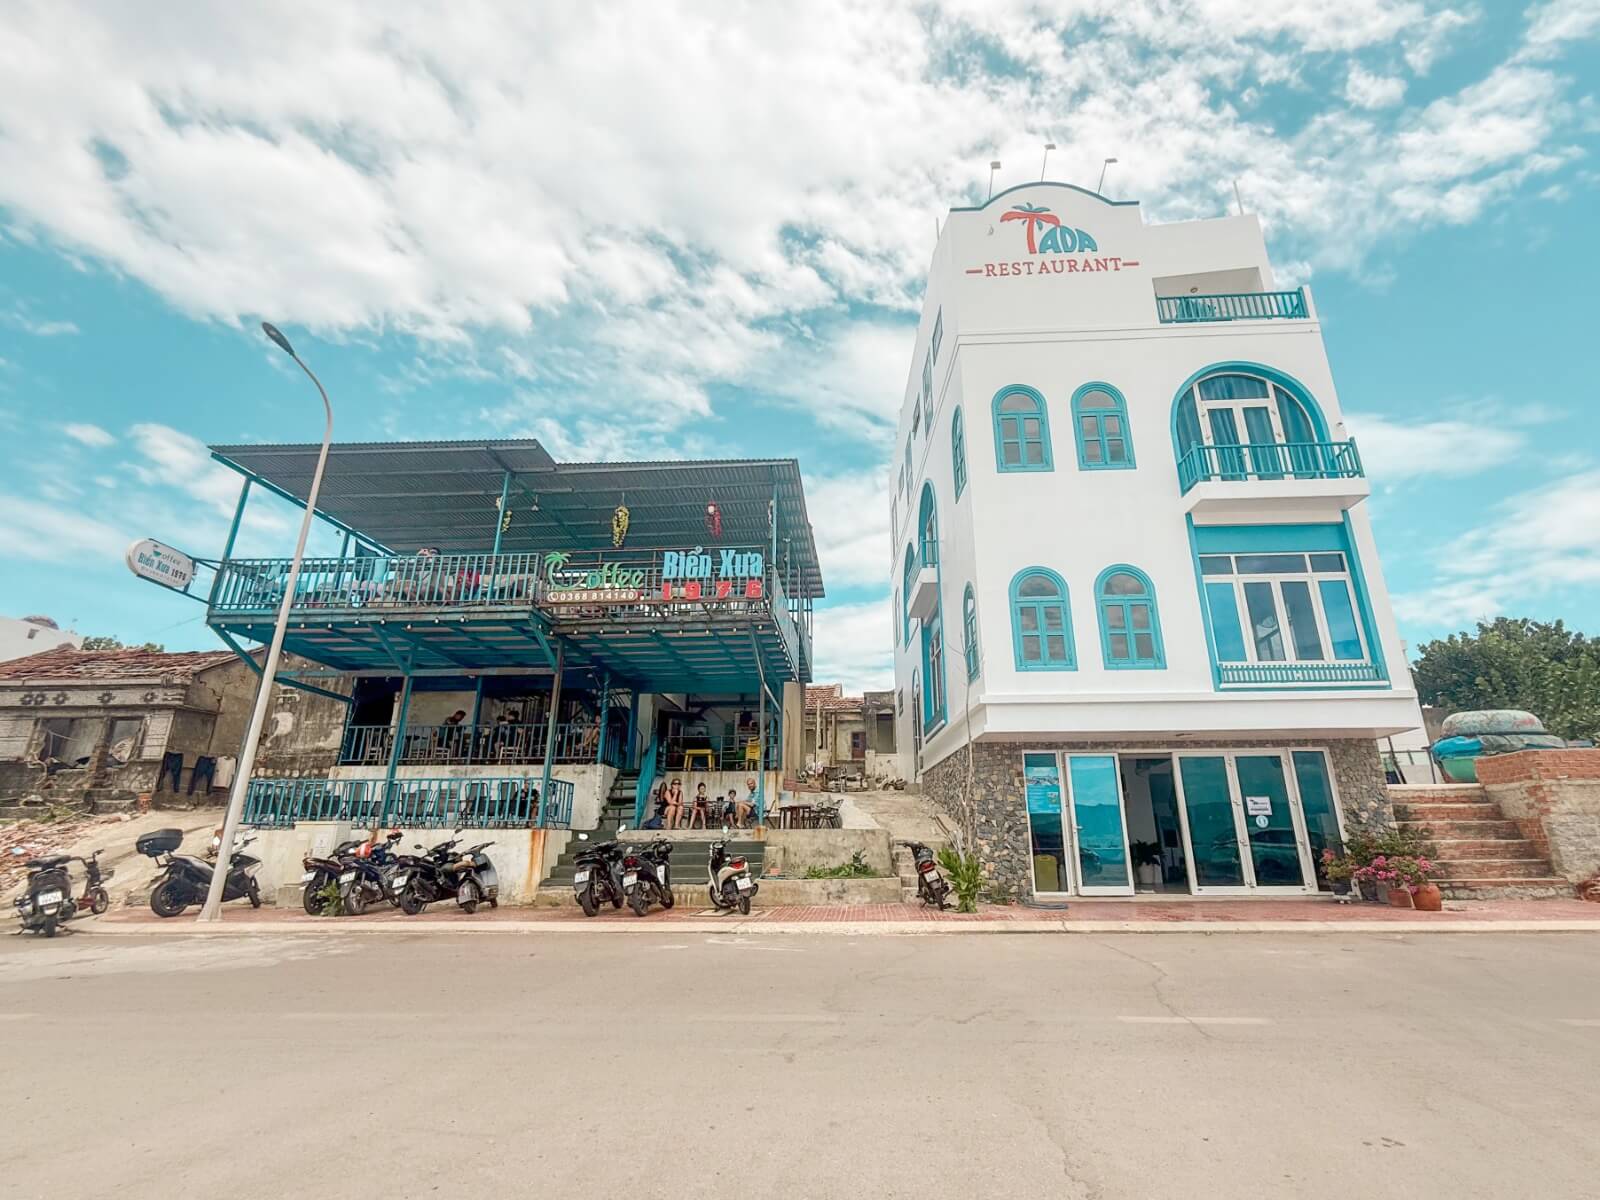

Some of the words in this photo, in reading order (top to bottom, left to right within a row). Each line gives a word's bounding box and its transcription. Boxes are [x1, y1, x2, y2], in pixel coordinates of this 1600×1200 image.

[984, 257, 1122, 277] RESTAURANT
[663, 545, 712, 579] Biển
[719, 549, 763, 577] Xưa
[560, 592, 588, 601] 0368
[591, 591, 635, 600] 814140
